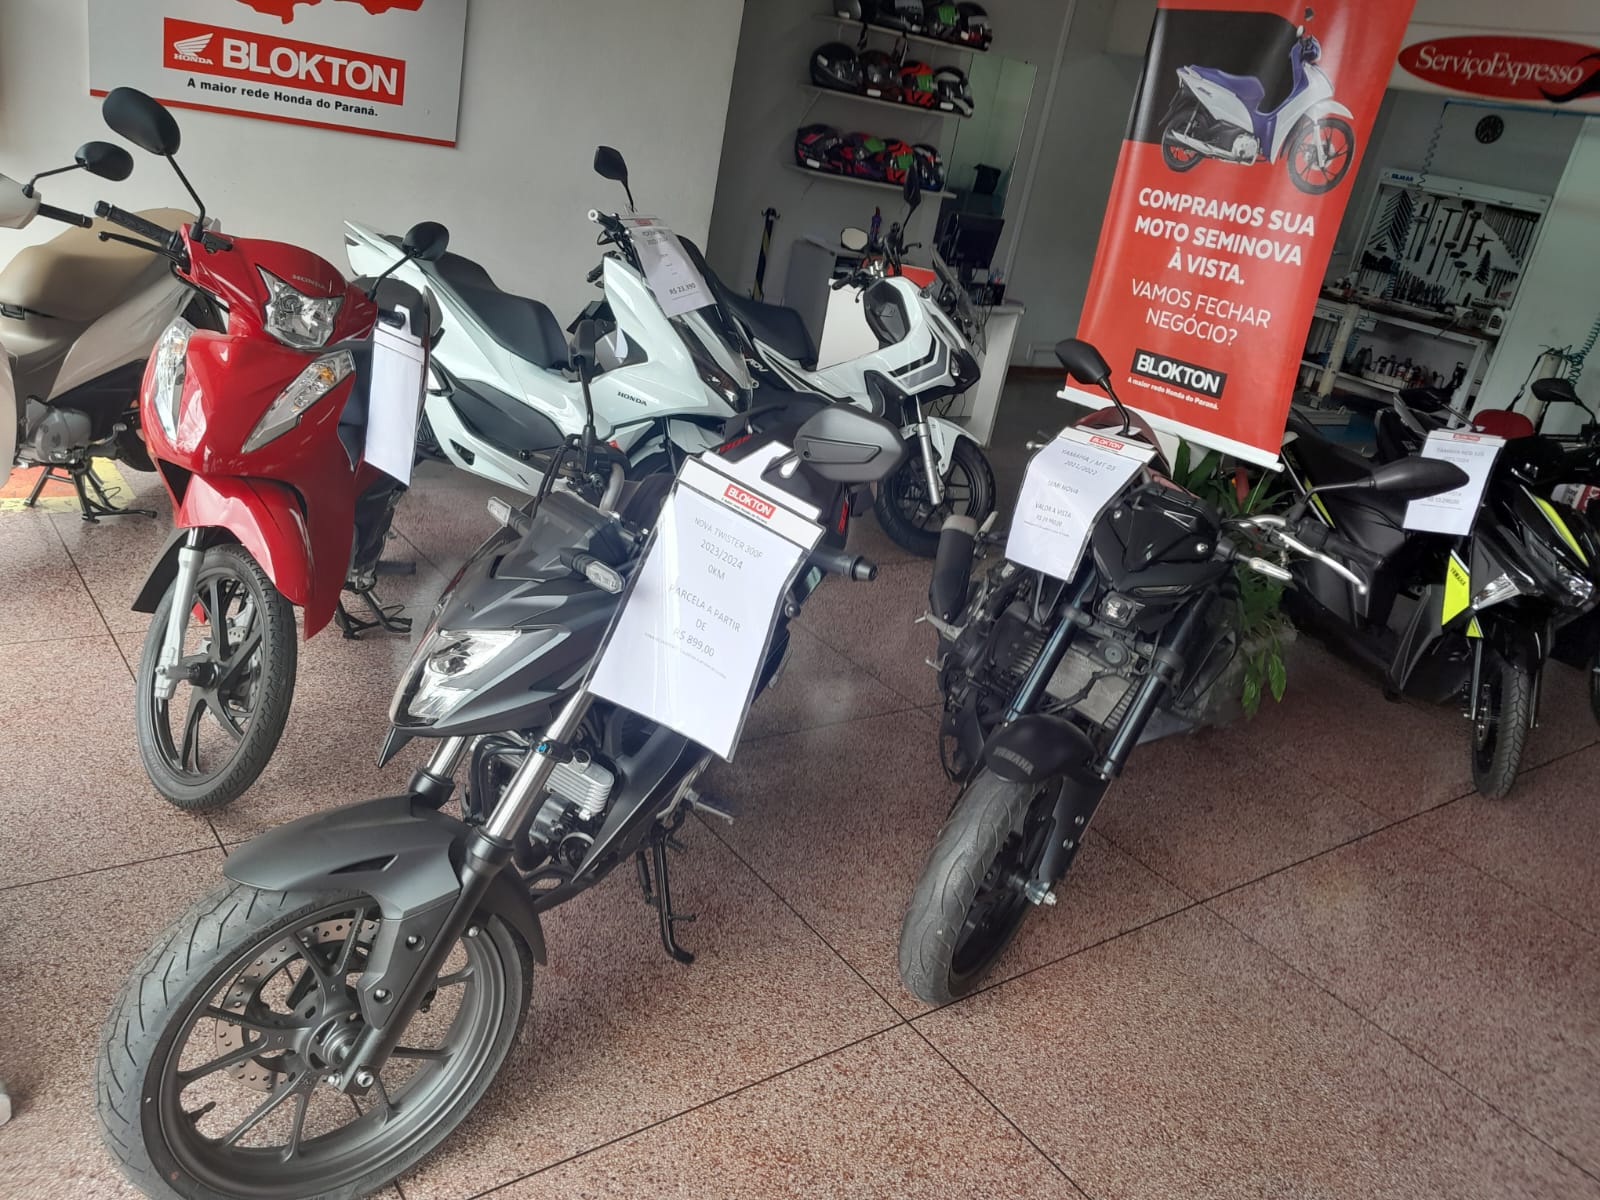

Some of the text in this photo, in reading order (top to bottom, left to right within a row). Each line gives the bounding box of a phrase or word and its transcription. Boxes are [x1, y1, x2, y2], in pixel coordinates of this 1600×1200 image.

[174, 53, 214, 65] HONDA
[222, 37, 398, 96] BLOKTON
[187, 77, 379, 116] A maior rede Honda do Paraná.
[1138, 187, 1315, 237] COMPRAMOS SUA
[1134, 215, 1302, 266] MOTO SEMINOVA
[1167, 246, 1245, 285] À VISTA.
[1131, 278, 1272, 329] VAMOS FECHAR
[1145, 307, 1238, 346] NEGÓCIO?
[1132, 379, 1151, 389] maior
[1151, 383, 1165, 394] rede
[1165, 387, 1185, 400] Honda
[1185, 394, 1194, 403] do
[1136, 353, 1221, 394] BLOKTON
[617, 391, 648, 406] HONDA
[726, 486, 773, 516] BLOKTON
[695, 517, 712, 533] NOVA
[714, 526, 744, 551] TWISTER
[700, 539, 743, 569] 2023/2024
[668, 584, 741, 632] PARCELA A PARTIR
[695, 618, 708, 632] DE
[686, 634, 715, 657] 899,00
